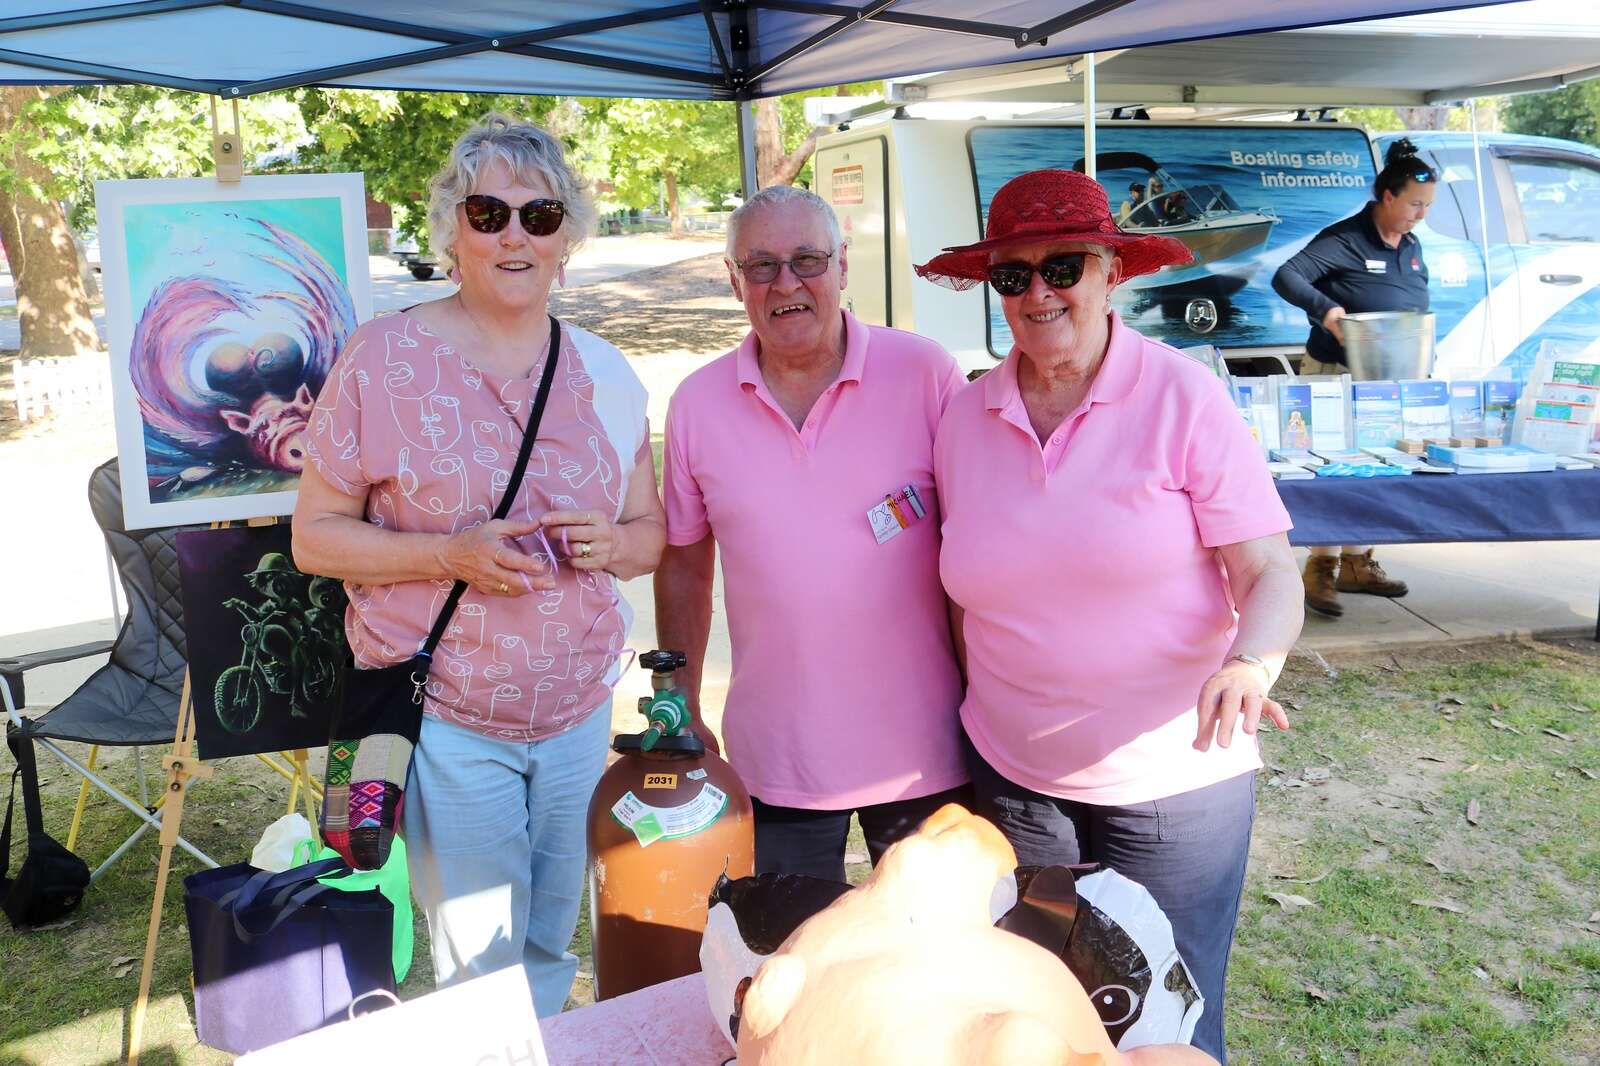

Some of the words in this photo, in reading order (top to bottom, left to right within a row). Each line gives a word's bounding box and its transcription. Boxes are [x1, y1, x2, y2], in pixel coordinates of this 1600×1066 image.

[1230, 150, 1302, 168] Boating
[1306, 151, 1360, 168] safety
[1260, 171, 1366, 187] information
[647, 776, 674, 785] 2031
